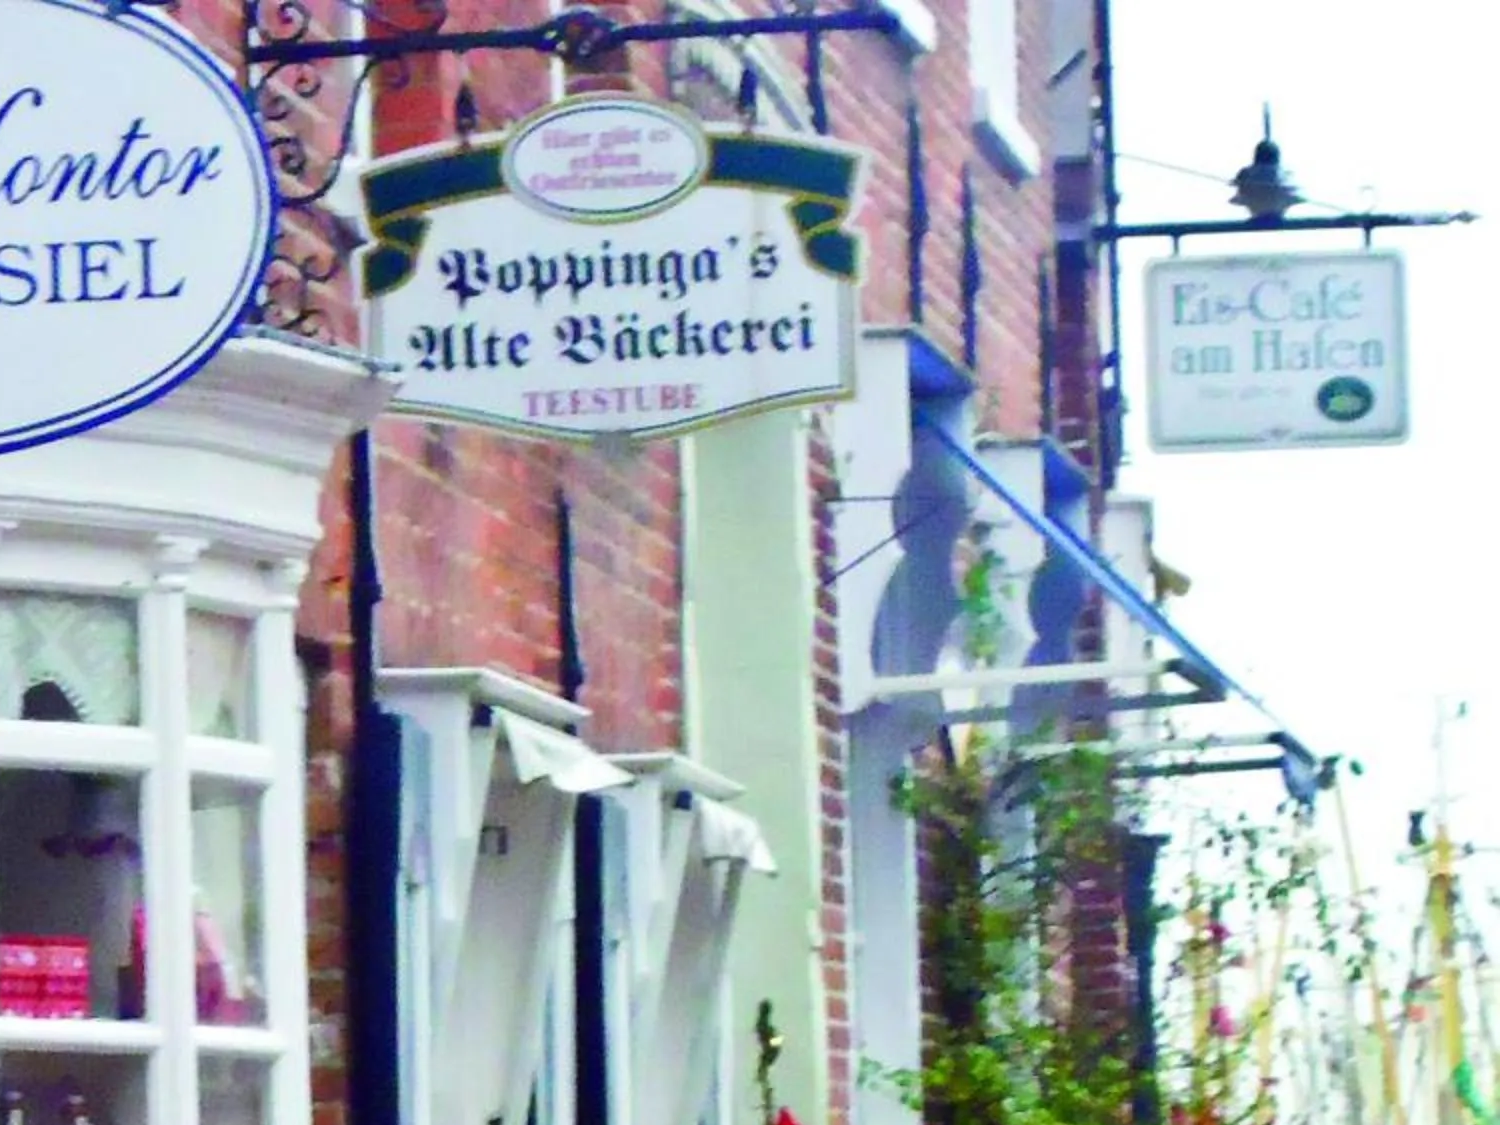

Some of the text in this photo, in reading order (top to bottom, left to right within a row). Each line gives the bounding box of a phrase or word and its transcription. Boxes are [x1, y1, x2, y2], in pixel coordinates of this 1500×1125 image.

[1171, 273, 1364, 326] Eis-Café
[409, 302, 816, 372] Alte Bäckerei
[1170, 322, 1385, 375] am Hafen
[522, 383, 703, 417] TEESTUBE
